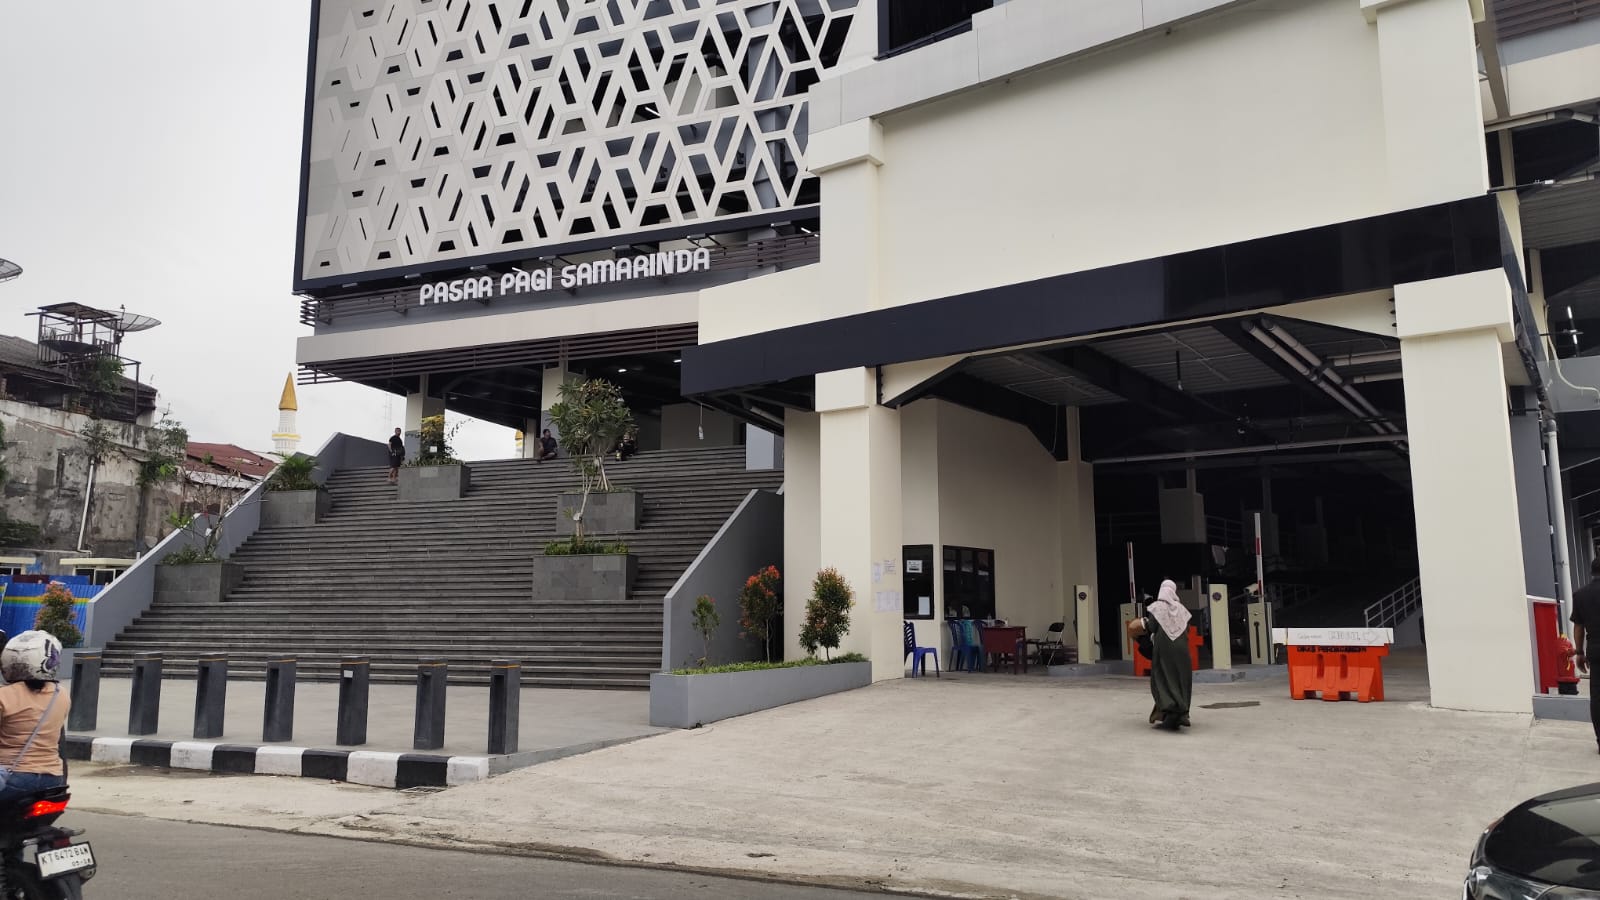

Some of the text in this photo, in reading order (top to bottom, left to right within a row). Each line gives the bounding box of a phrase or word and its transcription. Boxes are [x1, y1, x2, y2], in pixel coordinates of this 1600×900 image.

[419, 247, 711, 306] PASAR PAGI SAMARINDA
[41, 853, 53, 865] KT
